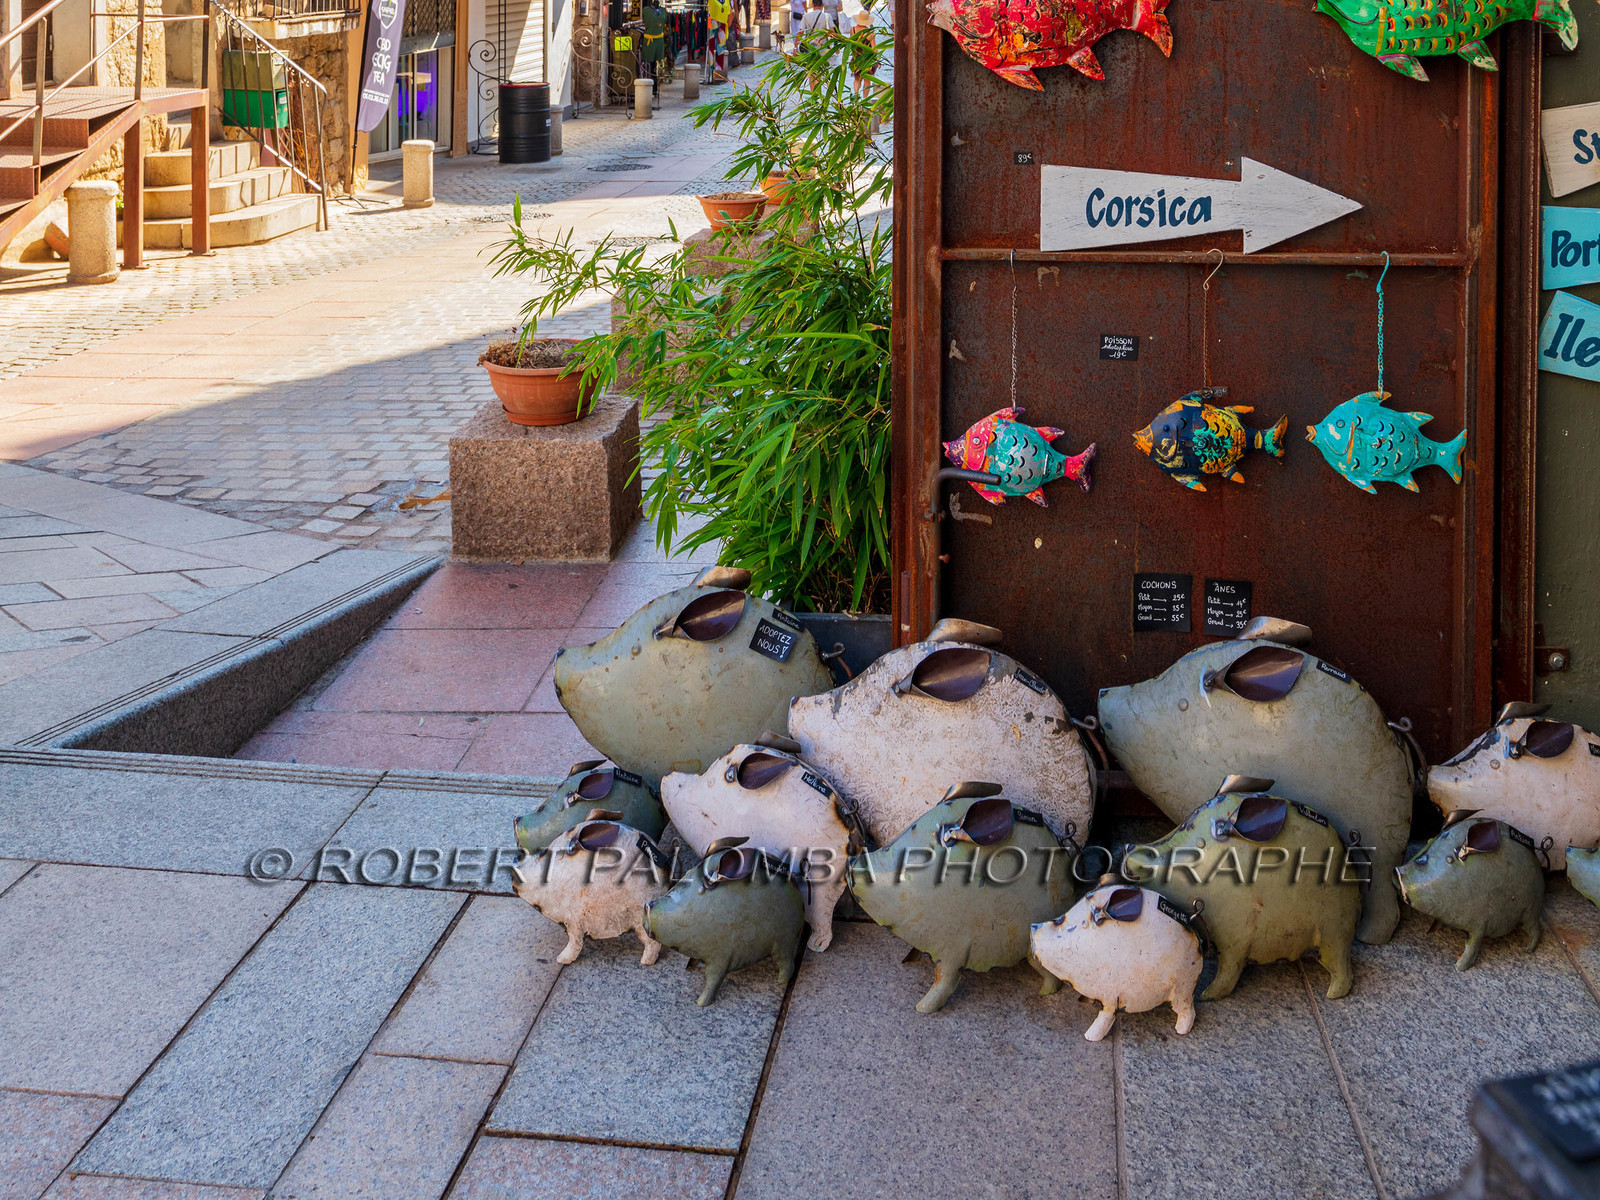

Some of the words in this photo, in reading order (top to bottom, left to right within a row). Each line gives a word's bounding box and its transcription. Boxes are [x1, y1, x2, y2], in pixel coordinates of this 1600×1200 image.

[373, 70, 385, 86] TEA
[1086, 188, 1212, 228] Corsica
[1551, 230, 1600, 268] Por
[1141, 581, 1177, 589] COCHONS
[1138, 593, 1151, 601] Petit
[1207, 596, 1221, 605] Petit
[1138, 604, 1153, 612] Moyen
[1207, 607, 1225, 618] Moyen
[1138, 613, 1153, 621] Grand
[1207, 618, 1224, 626] Grand
[759, 624, 792, 645] ADOPTEZ
